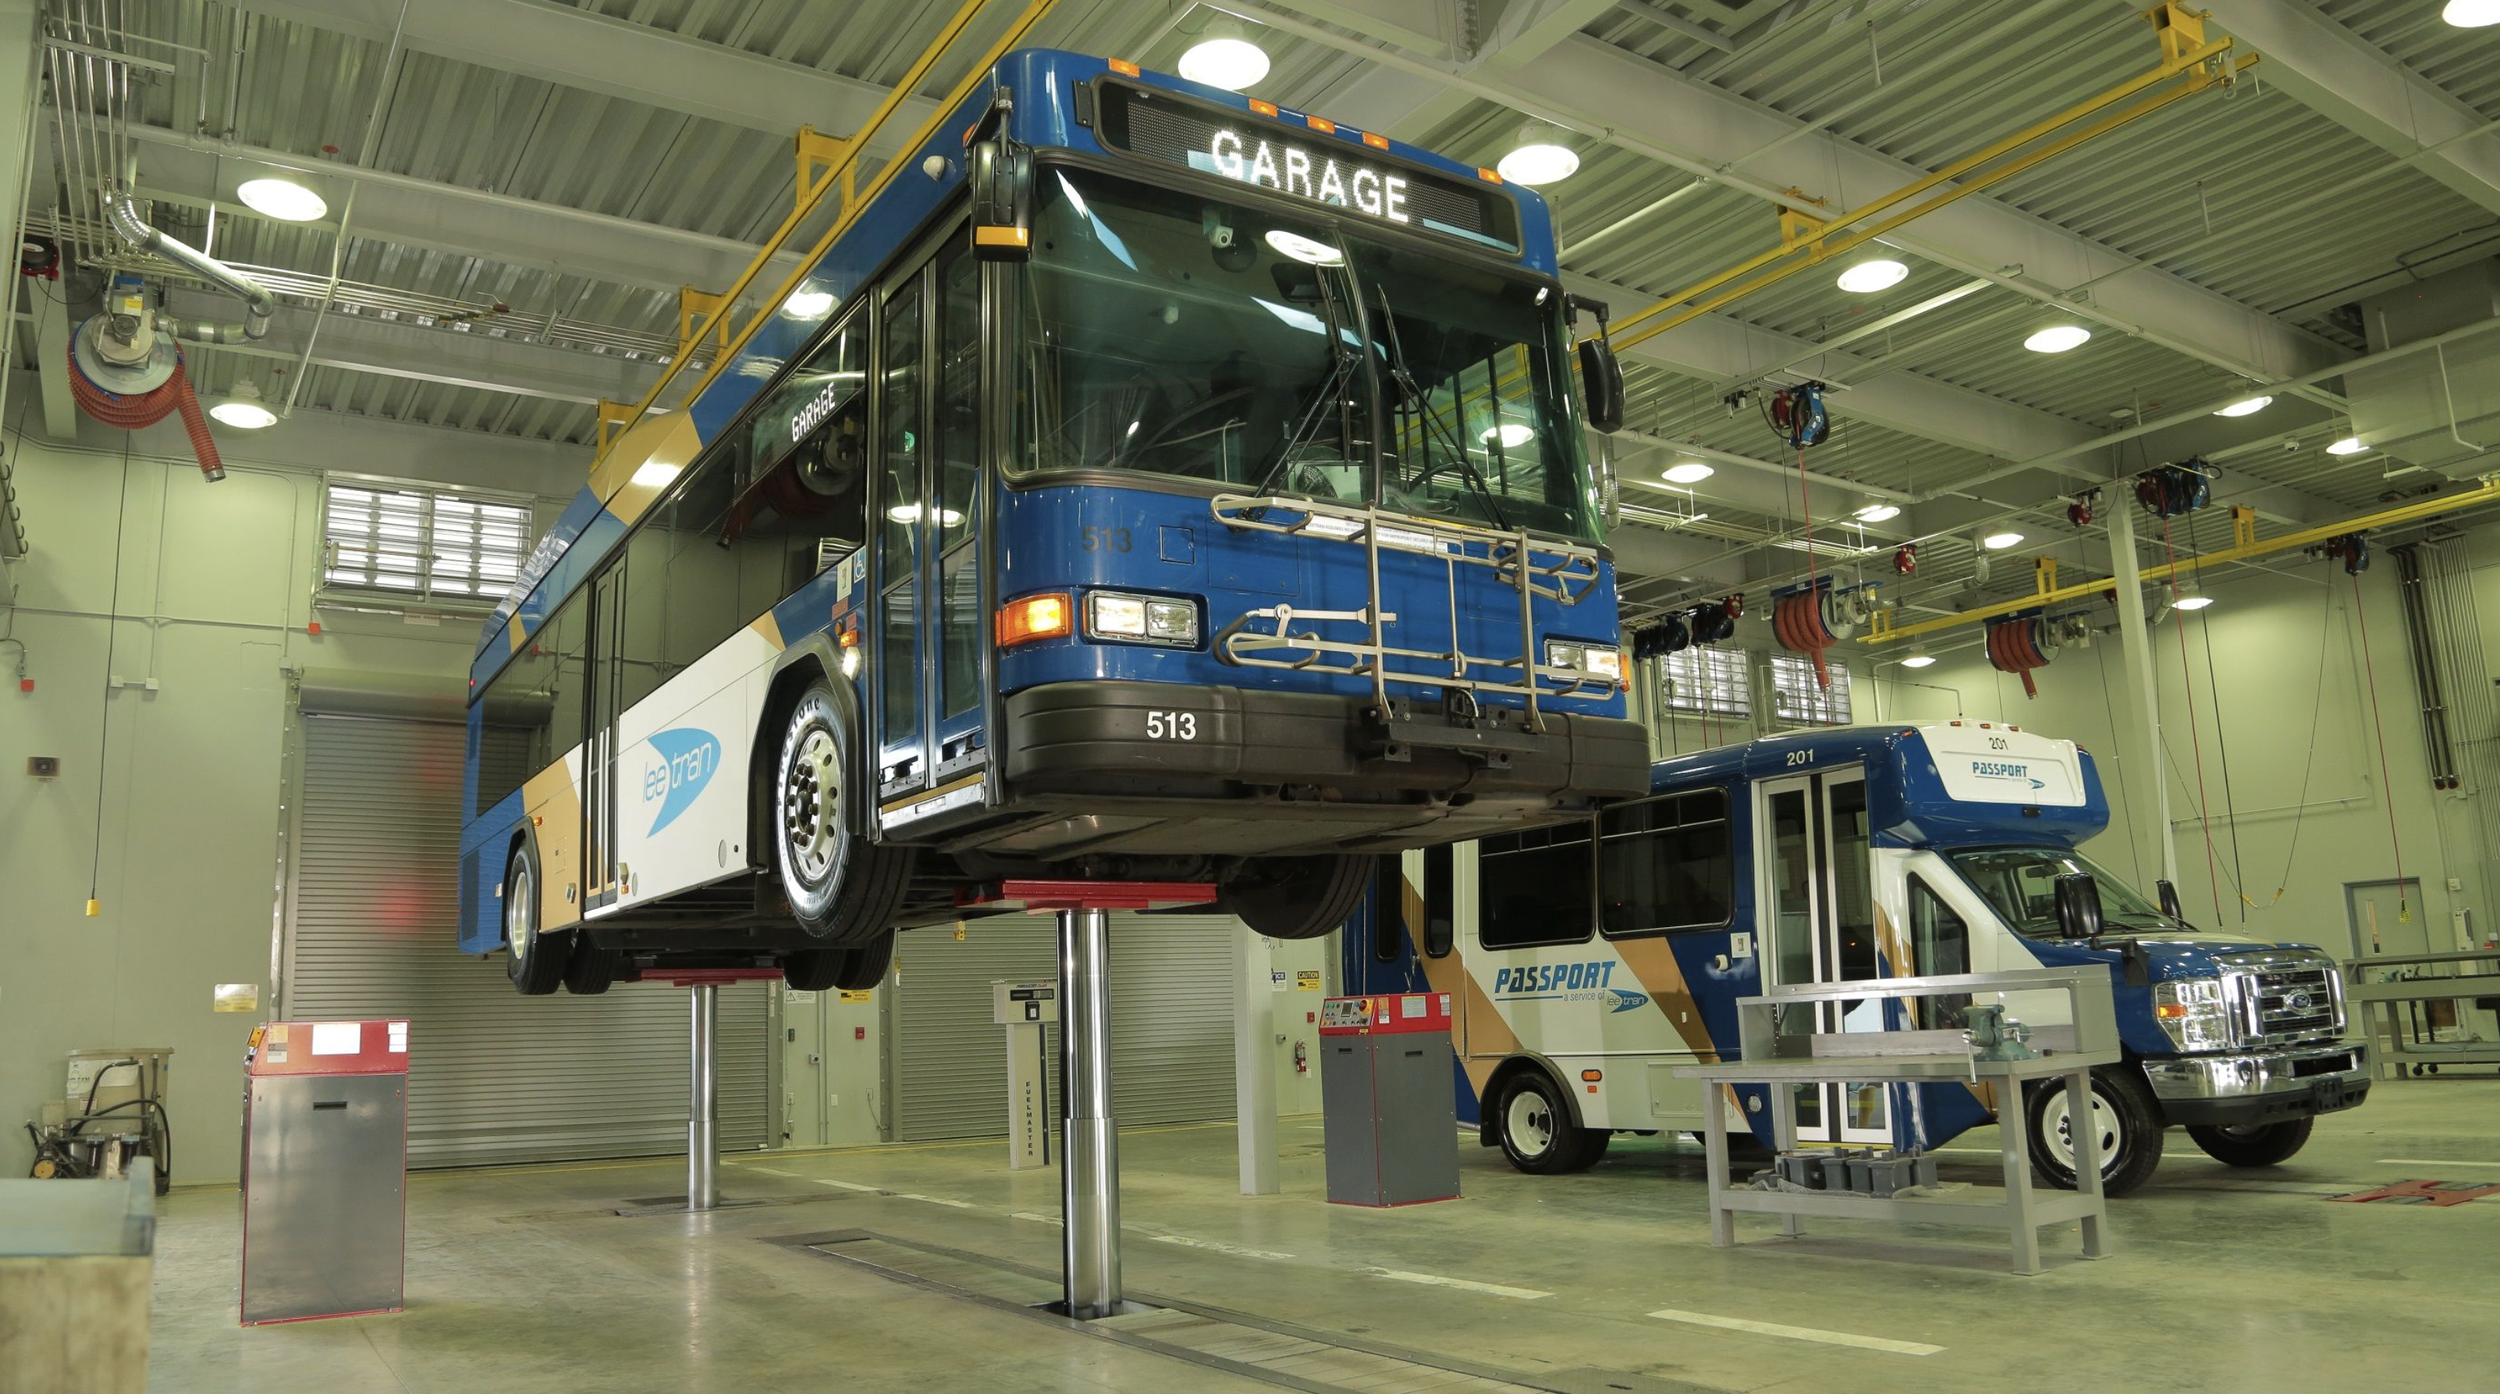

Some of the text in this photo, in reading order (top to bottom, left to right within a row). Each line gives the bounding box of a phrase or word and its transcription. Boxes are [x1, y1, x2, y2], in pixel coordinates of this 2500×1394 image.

[1212, 129, 1409, 223] GARAGE
[791, 381, 836, 443] GARAGE
[1081, 526, 1133, 553] 513
[1146, 711, 1197, 741] 513
[1786, 748, 1814, 767] 201
[1988, 737, 2009, 751] 201
[1972, 761, 2028, 778] PASSPORT
[1298, 971, 1319, 979] CAUTION
[1494, 960, 1617, 994] PASSPORT
[1563, 989, 1606, 1002] a service of
[1025, 1081, 1034, 1156] FUELMASTER
